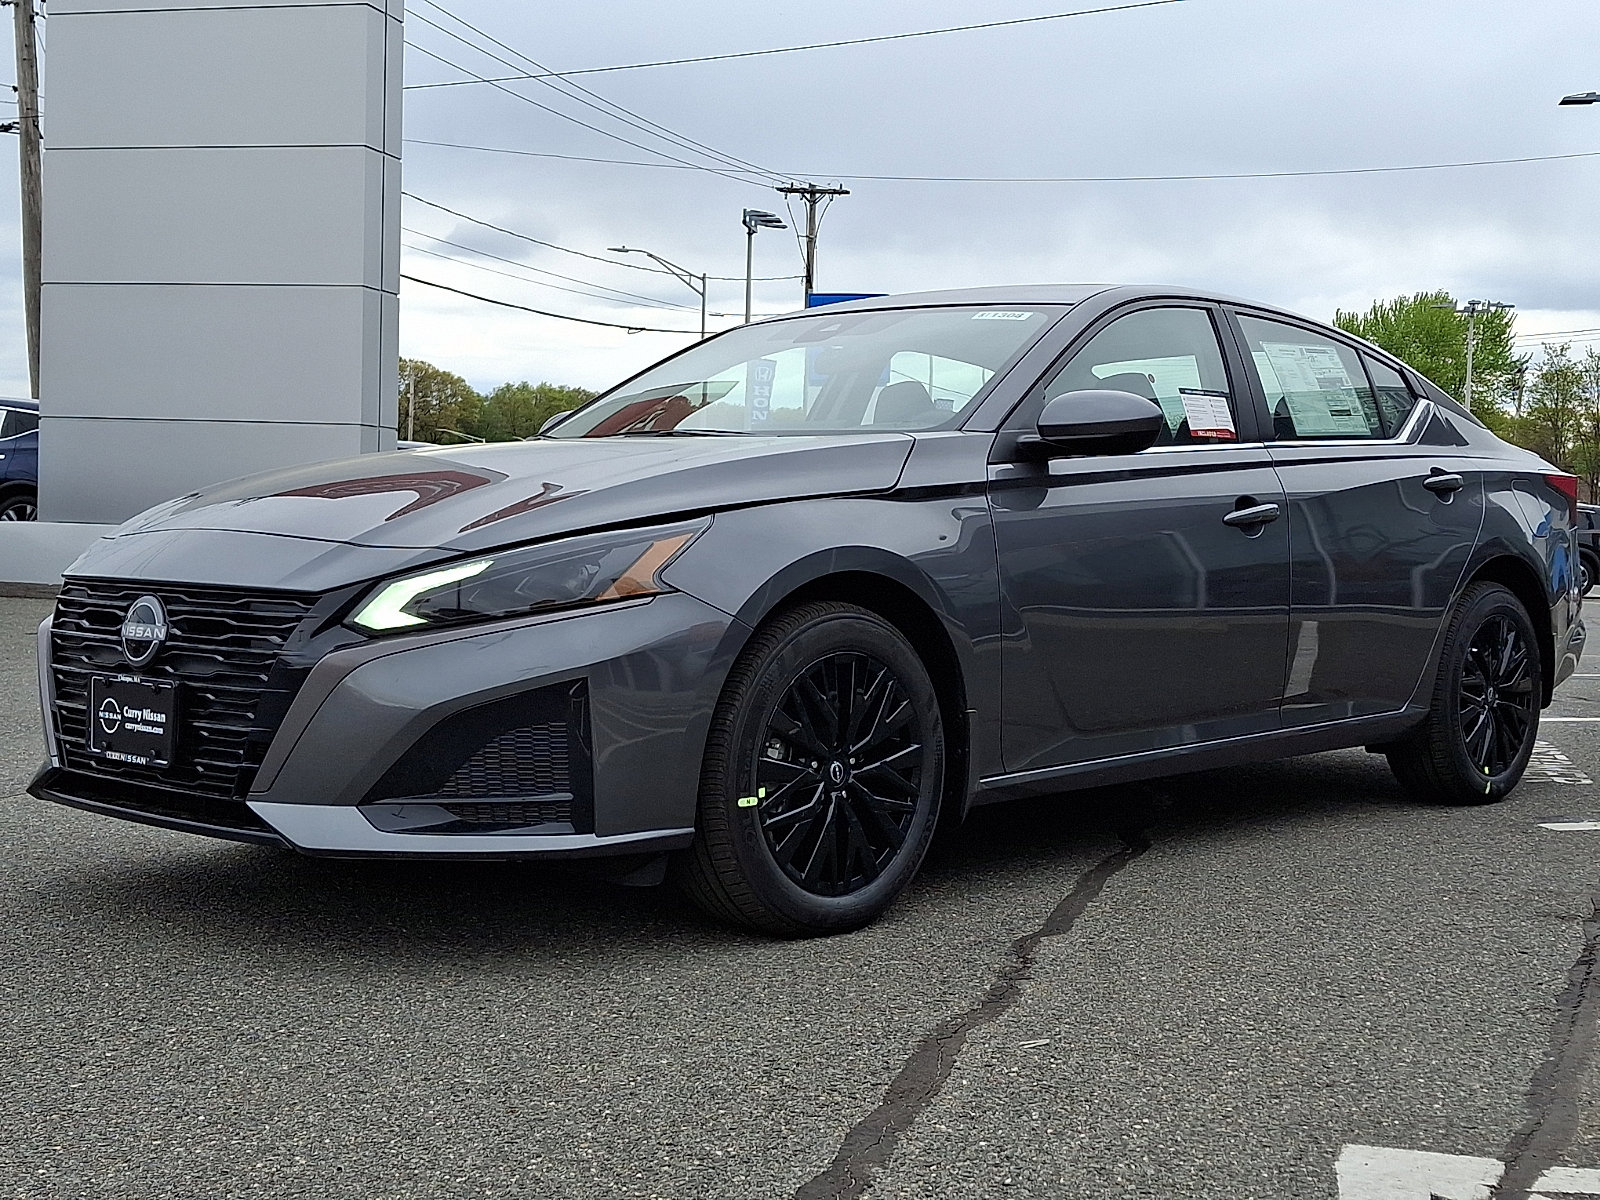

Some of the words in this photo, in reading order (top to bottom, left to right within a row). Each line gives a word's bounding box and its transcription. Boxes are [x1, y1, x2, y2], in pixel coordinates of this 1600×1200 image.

[751, 385, 770, 423] HON
[122, 625, 165, 639] NISSAN
[98, 711, 122, 721] NISSAN
[123, 706, 142, 722] Curry
[142, 708, 166, 723] Nissan
[120, 753, 146, 766] NISSAN
